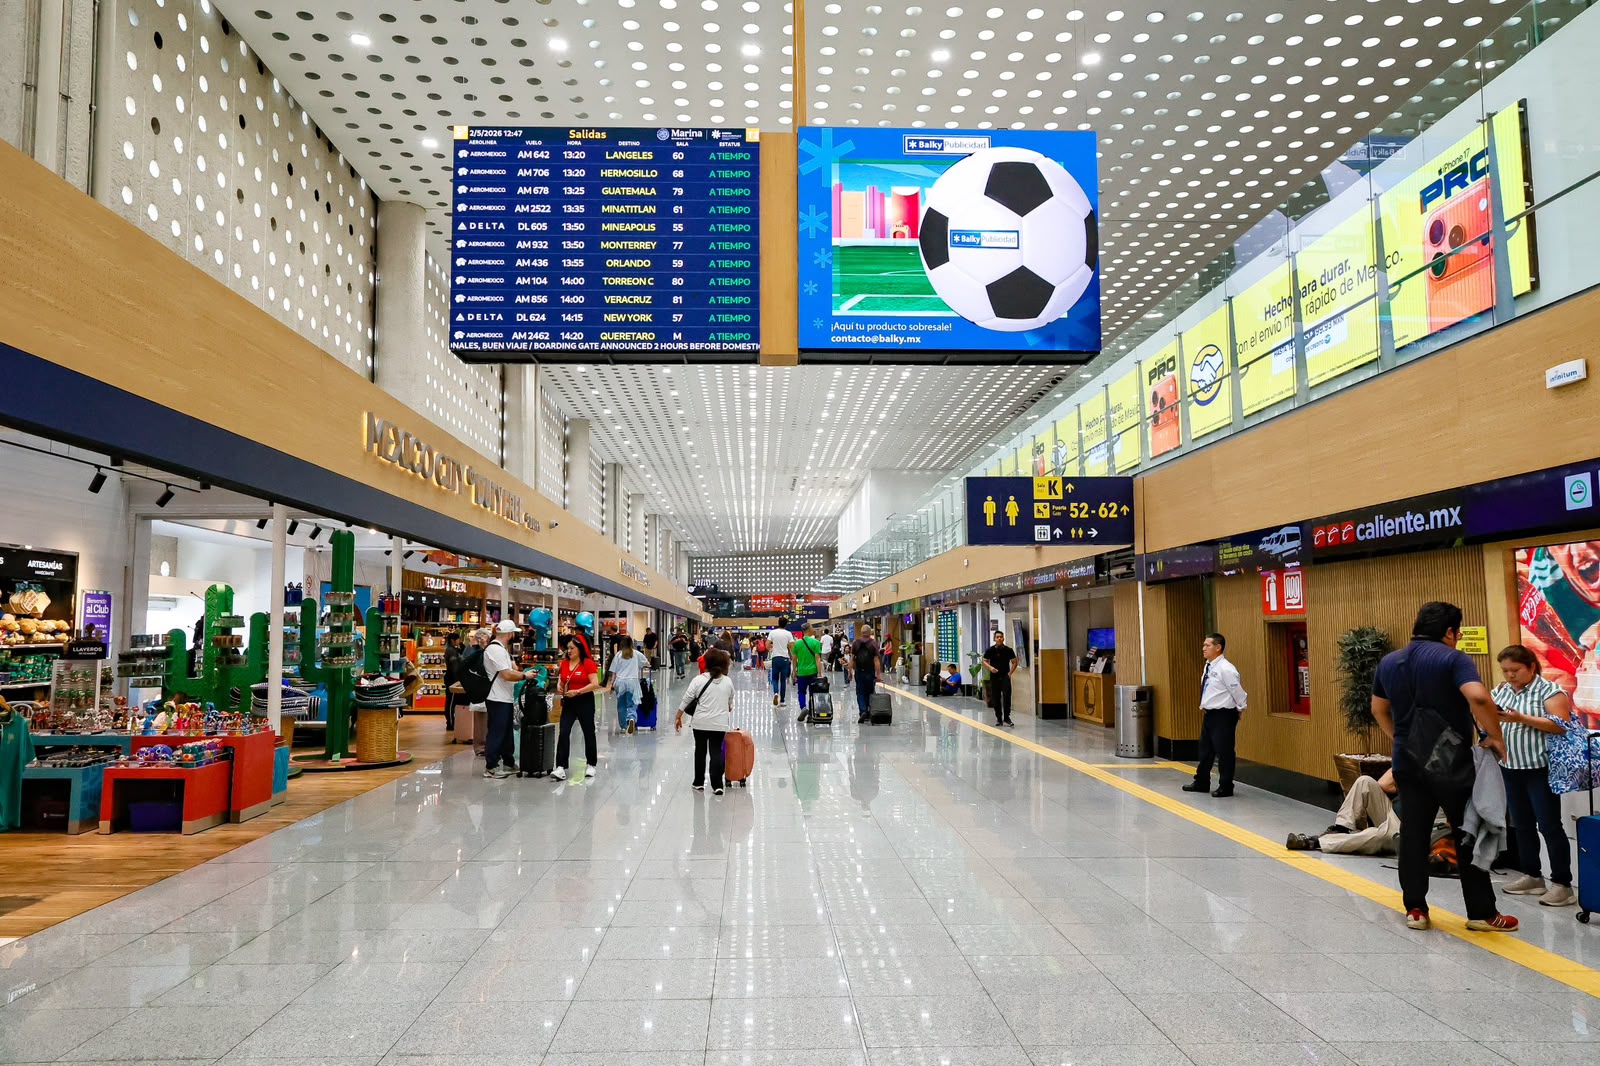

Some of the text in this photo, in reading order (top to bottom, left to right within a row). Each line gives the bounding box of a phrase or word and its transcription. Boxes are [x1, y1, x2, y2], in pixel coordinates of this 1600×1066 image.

[569, 130, 606, 139] Salidas
[919, 140, 986, 150] Balky Publicidad
[1442, 148, 1470, 174] iPhone 17
[601, 170, 658, 178] HERMOSILLO
[961, 235, 1016, 244] Balky Publicidad
[1264, 296, 1292, 321] Hecho
[1320, 258, 1350, 286] durar.
[1250, 331, 1258, 348] el
[1259, 320, 1281, 342] envío
[1305, 287, 1337, 316] rápido
[1340, 278, 1353, 296] de
[831, 322, 854, 332] ¡Aquí
[867, 322, 907, 333] producto
[909, 323, 952, 331] sobresale!
[831, 334, 921, 344] contacto@balky.mx
[1148, 354, 1176, 386] PRO
[1048, 480, 1058, 496] K
[1069, 502, 1089, 518] 52
[1098, 502, 1118, 518] 62
[1356, 506, 1462, 541] caliente.mx
[28, 560, 63, 570] ARTESANÍAS
[93, 605, 109, 614] Club
